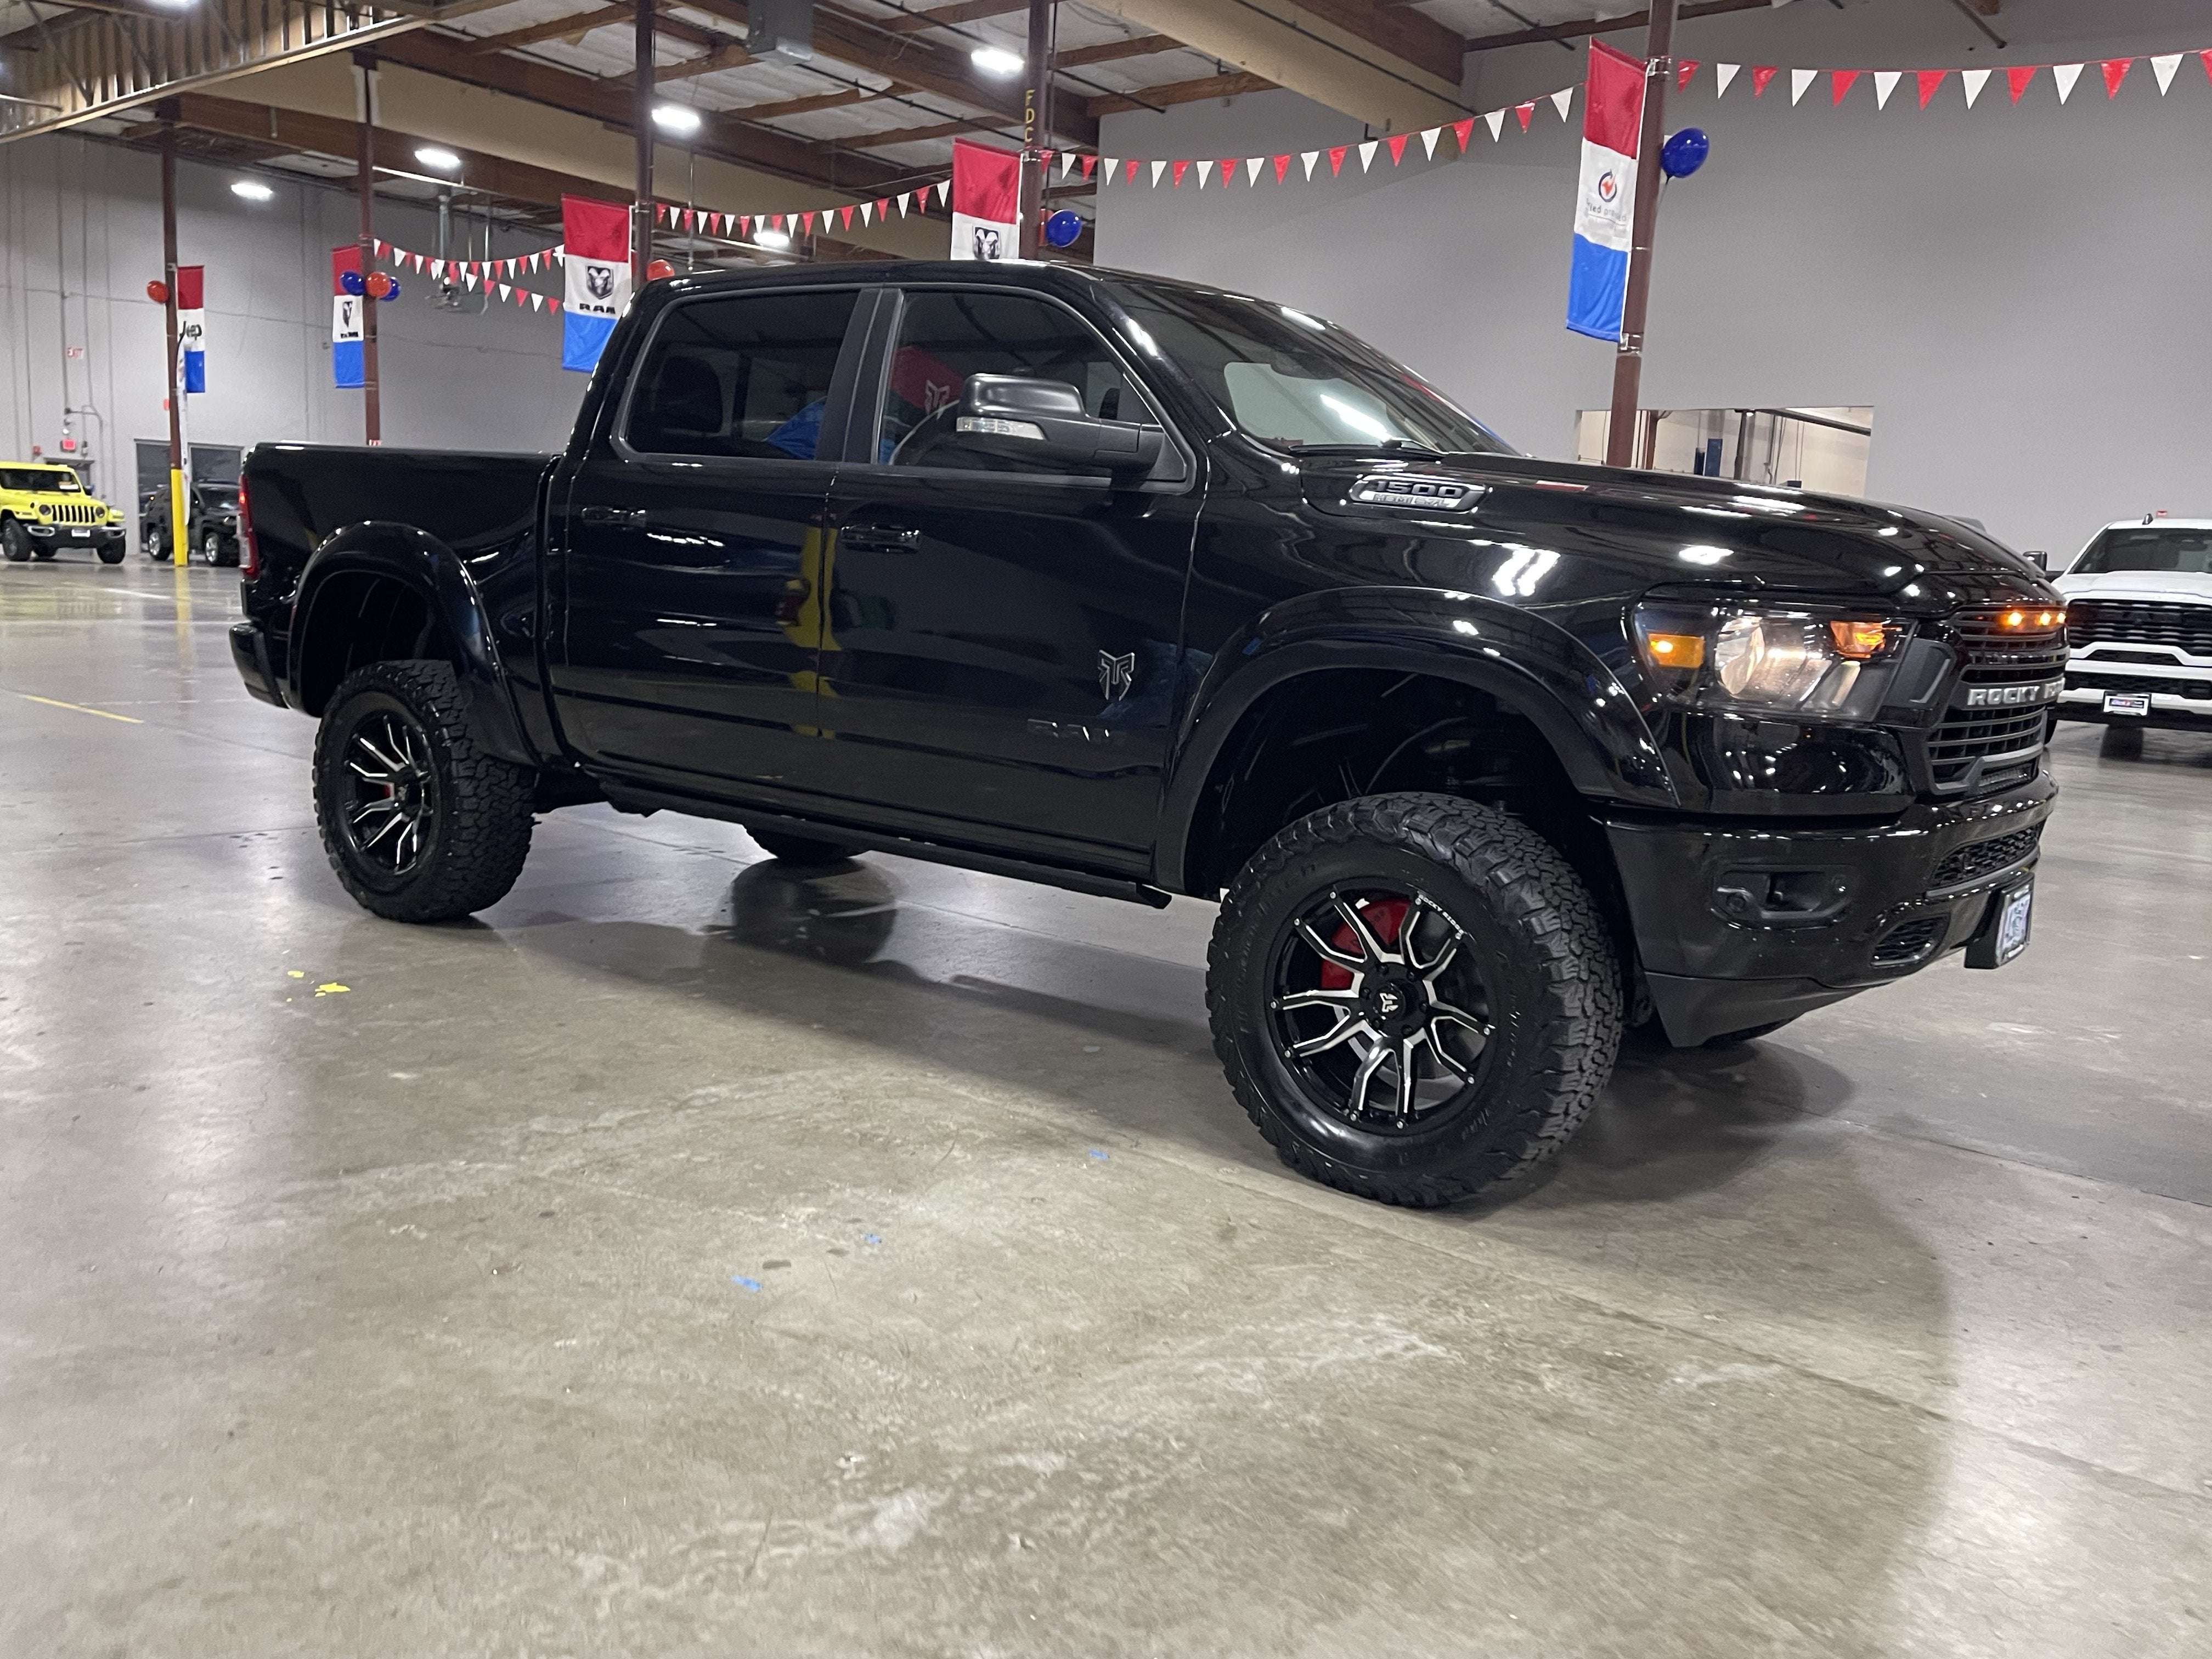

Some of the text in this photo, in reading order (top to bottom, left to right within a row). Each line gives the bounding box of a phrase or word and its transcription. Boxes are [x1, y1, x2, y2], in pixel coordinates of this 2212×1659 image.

[579, 303, 616, 314] RAM
[1376, 481, 1463, 498] 1500
[1967, 686, 2040, 706] ROCKY
